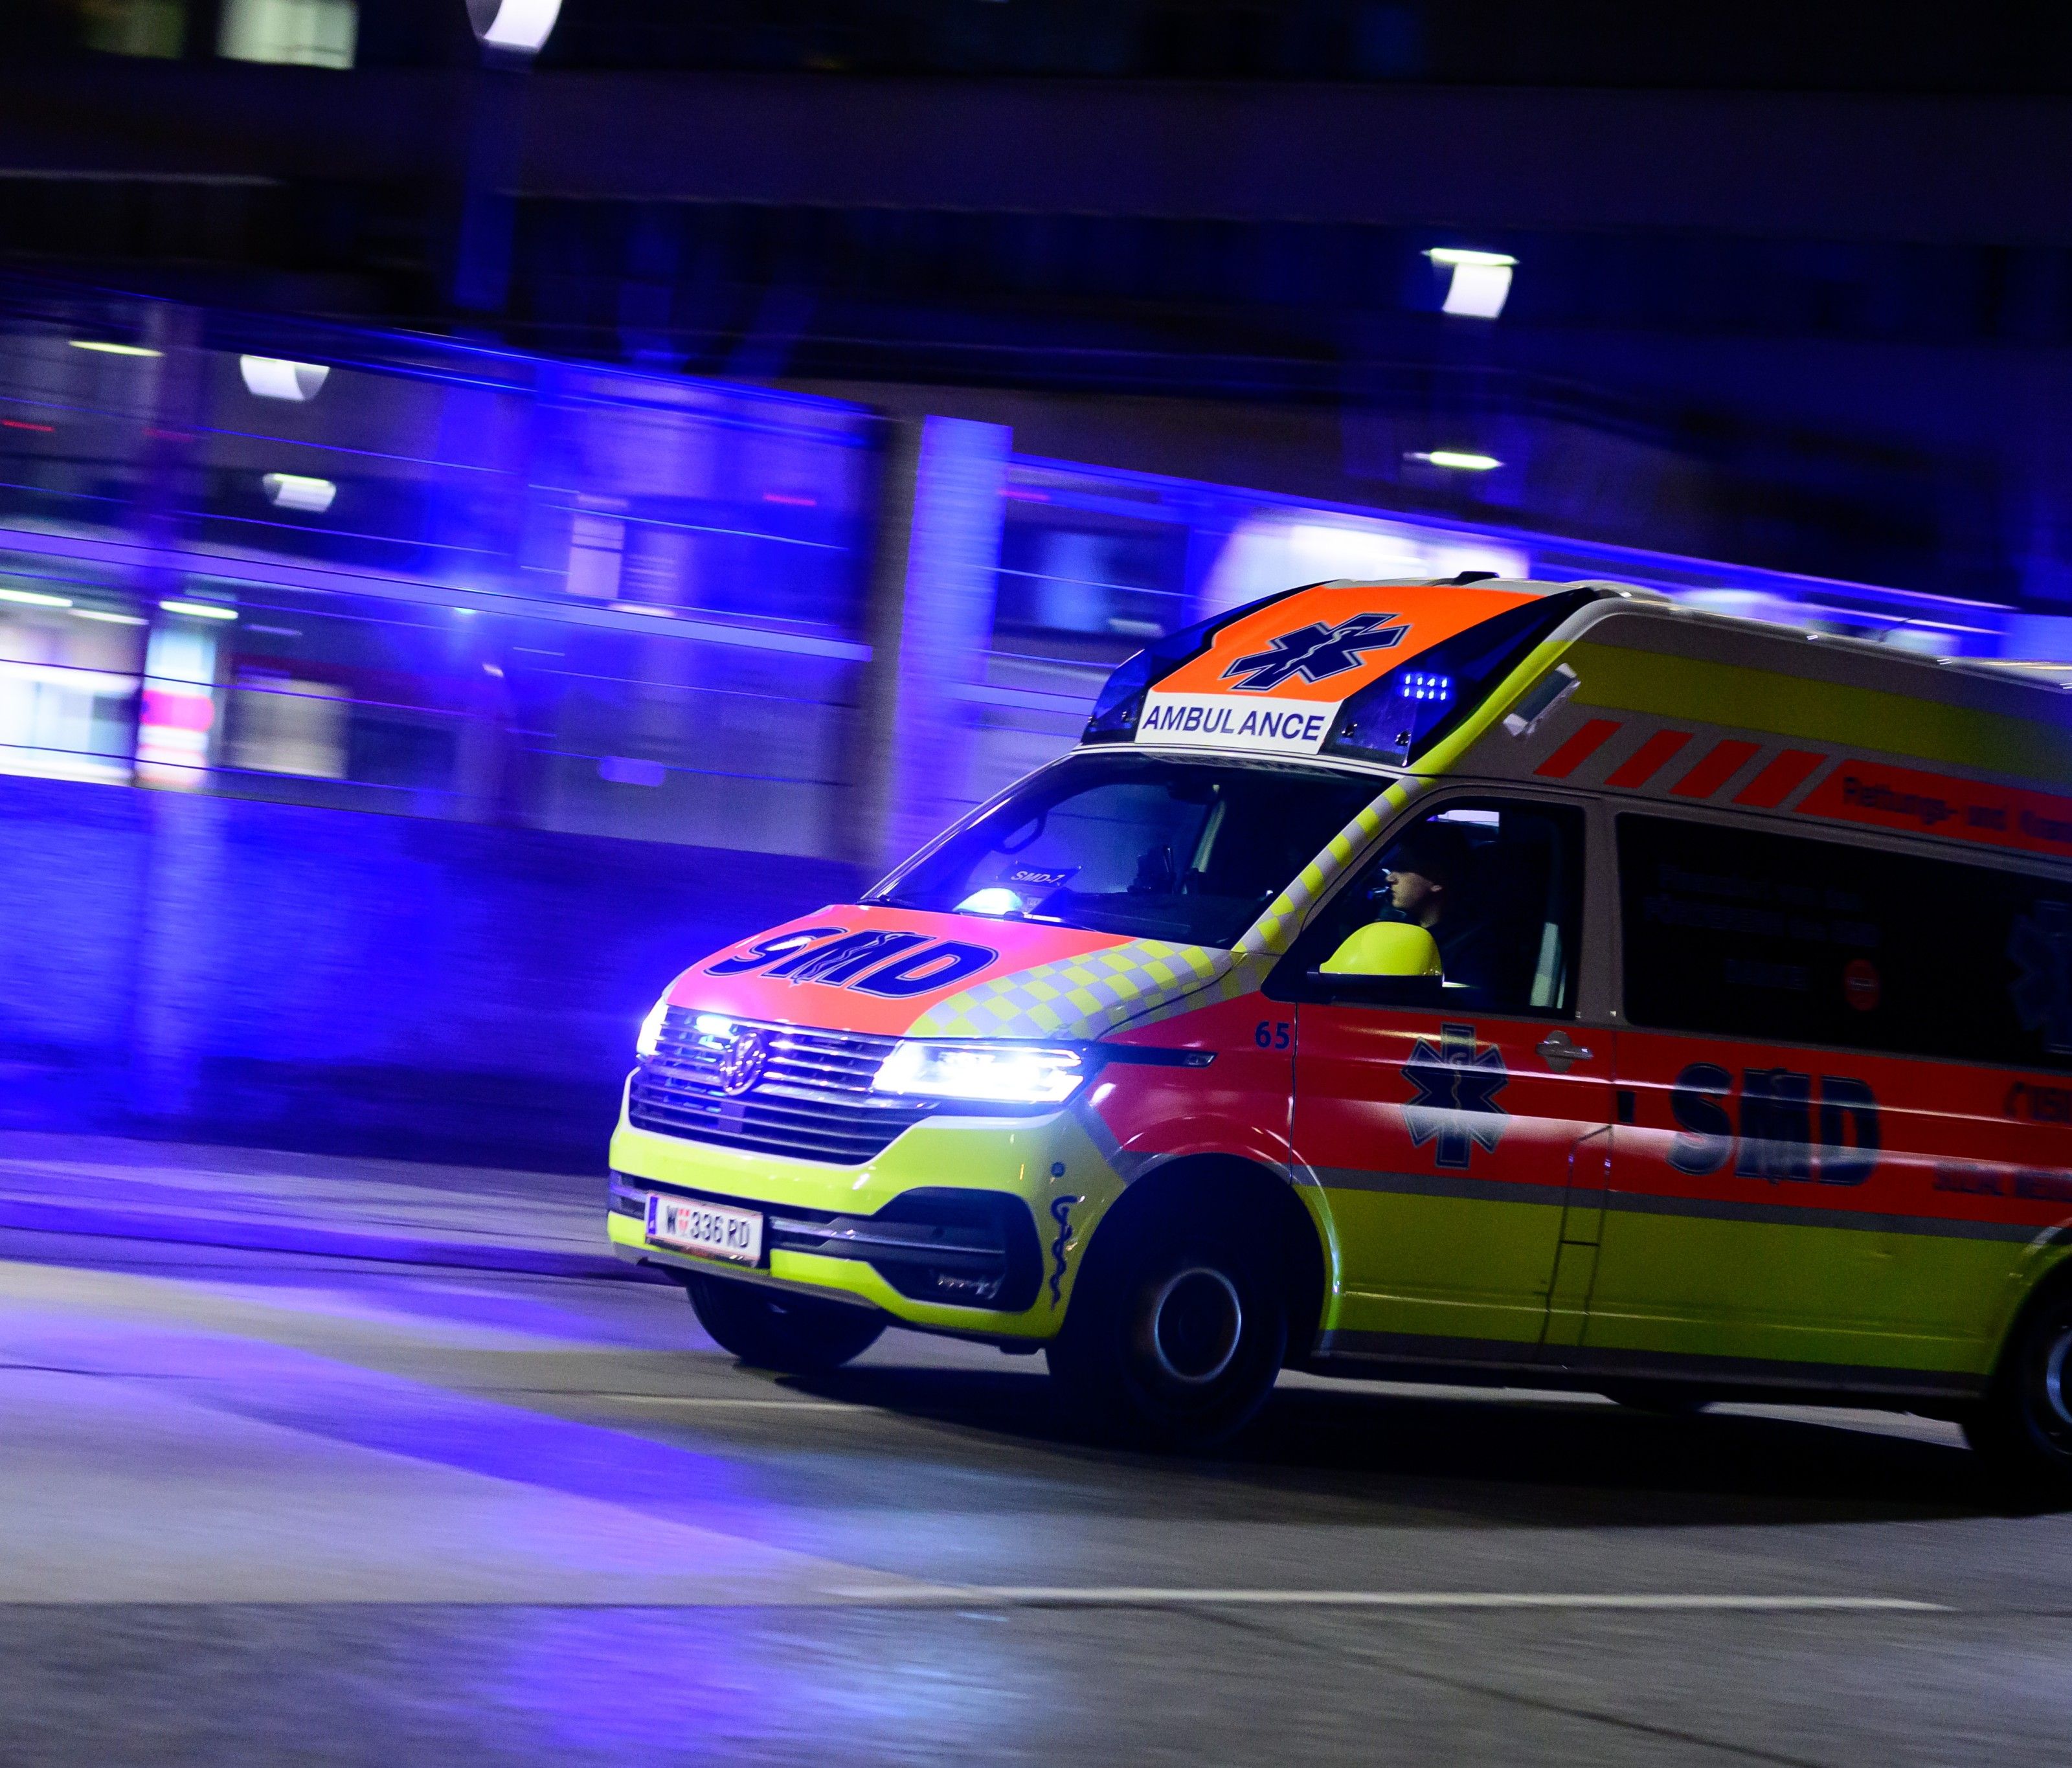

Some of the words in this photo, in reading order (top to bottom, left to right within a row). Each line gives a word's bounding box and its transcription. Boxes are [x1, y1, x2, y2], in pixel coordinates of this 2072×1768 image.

[1142, 705, 1325, 741] AMBULANCE
[704, 927, 998, 998] SMD
[1255, 1021, 1290, 1049] 65
[1665, 1062, 1878, 1186] SMD
